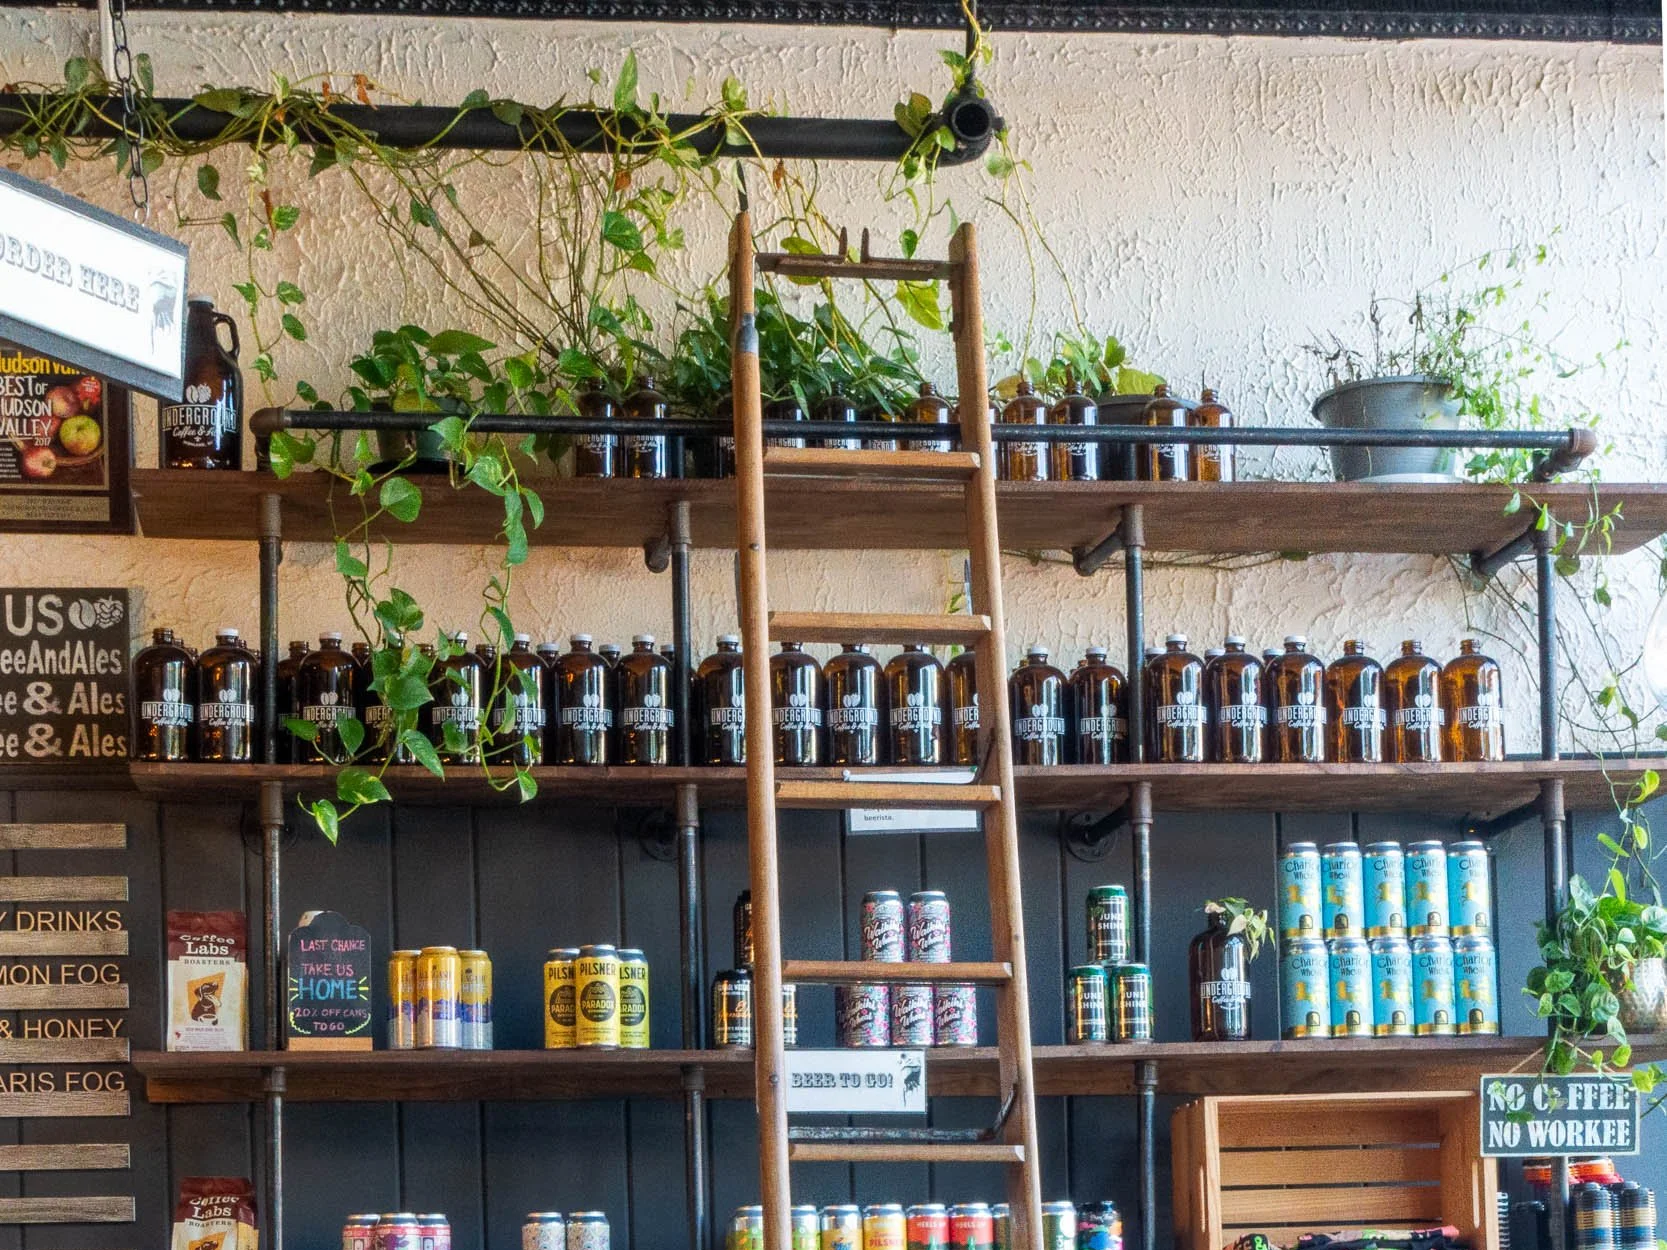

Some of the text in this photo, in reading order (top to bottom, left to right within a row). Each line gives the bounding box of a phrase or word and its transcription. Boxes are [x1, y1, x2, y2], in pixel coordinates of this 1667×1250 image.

[79, 263, 140, 314] HERE
[0, 352, 50, 374] udson
[35, 382, 48, 395] OF
[34, 437, 51, 446] 2017
[5, 594, 64, 637] US
[23, 681, 126, 715] & Ales
[24, 723, 127, 758] & Ales
[16, 911, 122, 932] DRINKS
[180, 934, 235, 944] Coffee
[185, 941, 229, 955] Labs
[301, 939, 366, 952] LAST CHANCE
[61, 964, 121, 985] FOG
[302, 964, 354, 977] TAKE US
[580, 963, 616, 976] PILSNER
[299, 977, 358, 1001] HOME
[294, 1007, 367, 1019] 20% OFF CANS
[24, 1018, 123, 1039] HONEY
[313, 1021, 345, 1031] TO GO
[65, 1071, 126, 1092] FOG
[791, 1072, 893, 1088] BEER TO GO!
[1488, 1083, 1630, 1111] NO CFFEE
[1488, 1119, 1631, 1148] NO WORKEE
[192, 1206, 232, 1219] Labs
